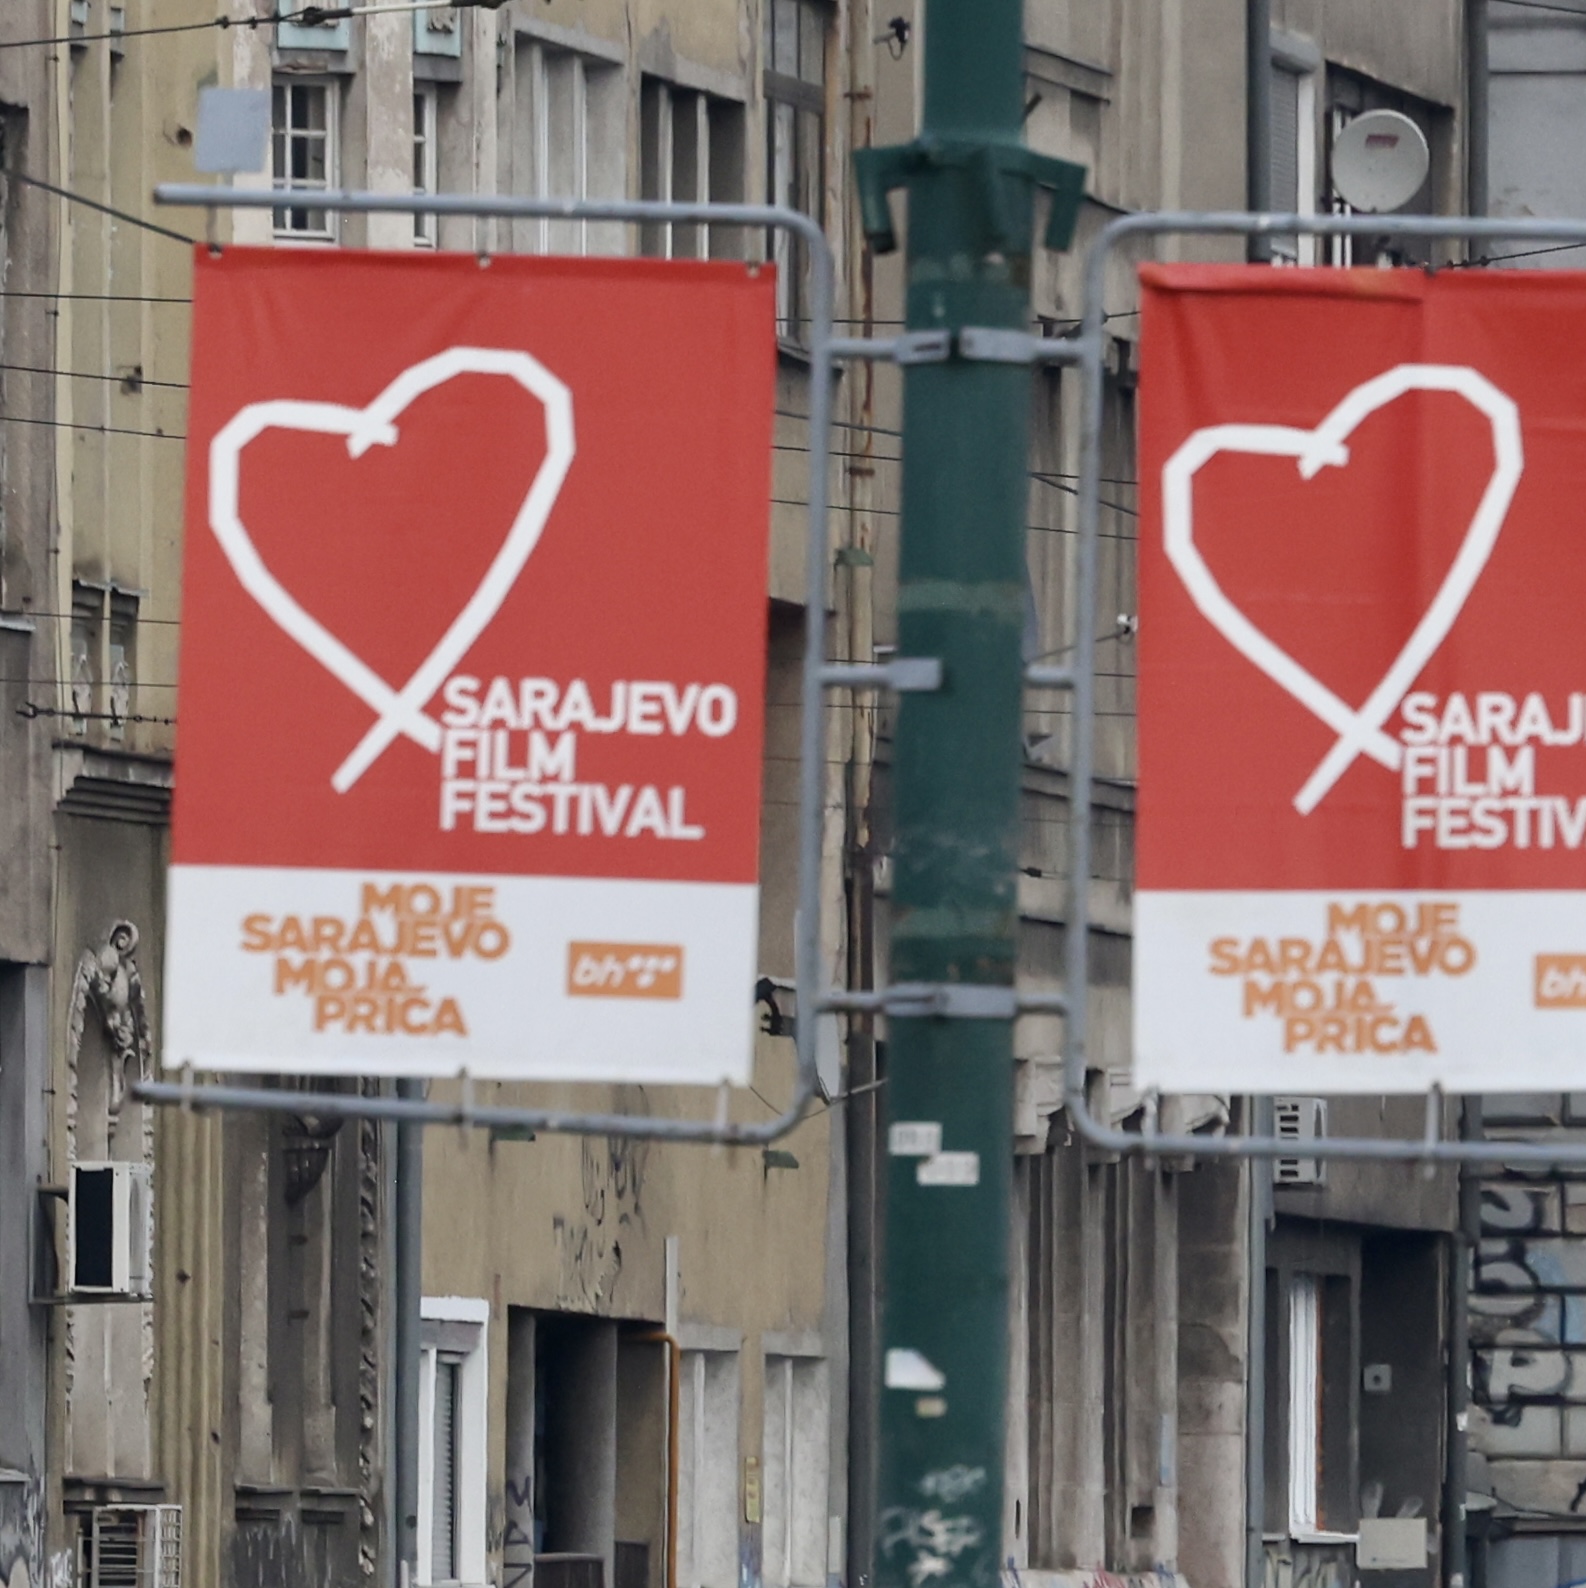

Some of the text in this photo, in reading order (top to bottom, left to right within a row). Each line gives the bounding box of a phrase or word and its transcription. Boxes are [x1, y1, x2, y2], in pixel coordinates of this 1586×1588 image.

[442, 677, 736, 736] SARAJEVO
[442, 731, 575, 783] FILM
[1403, 747, 1534, 795] FILM
[440, 782, 704, 839] FESTIVAL
[362, 882, 495, 917] MOJE
[1328, 903, 1460, 937] MOJE
[241, 913, 510, 960] SARAJEVO
[1209, 936, 1476, 977] SARAJEVO
[275, 956, 407, 996] MOJA
[1243, 979, 1379, 1019] MOJA
